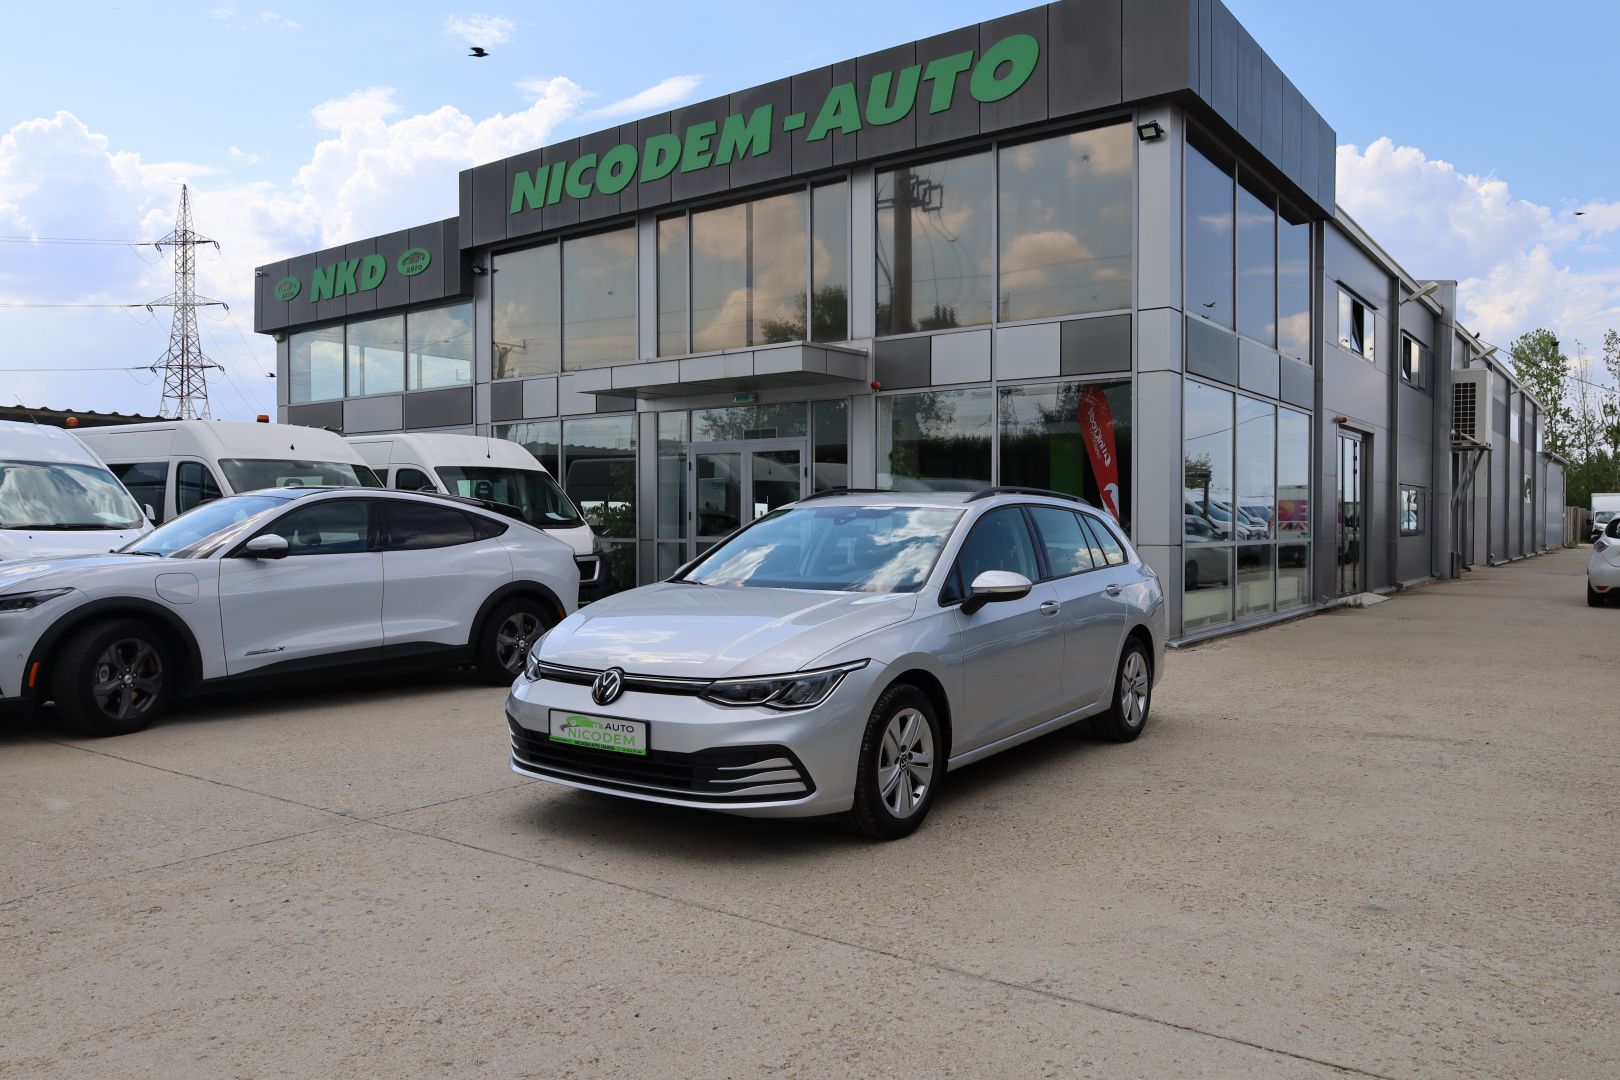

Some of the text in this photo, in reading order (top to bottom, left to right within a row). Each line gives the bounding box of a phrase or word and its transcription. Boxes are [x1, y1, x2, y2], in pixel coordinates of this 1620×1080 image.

[406, 264, 423, 274] AUTO
[310, 254, 387, 303] NKD
[604, 722, 635, 733] AUTO
[568, 727, 636, 746] NICODEM
